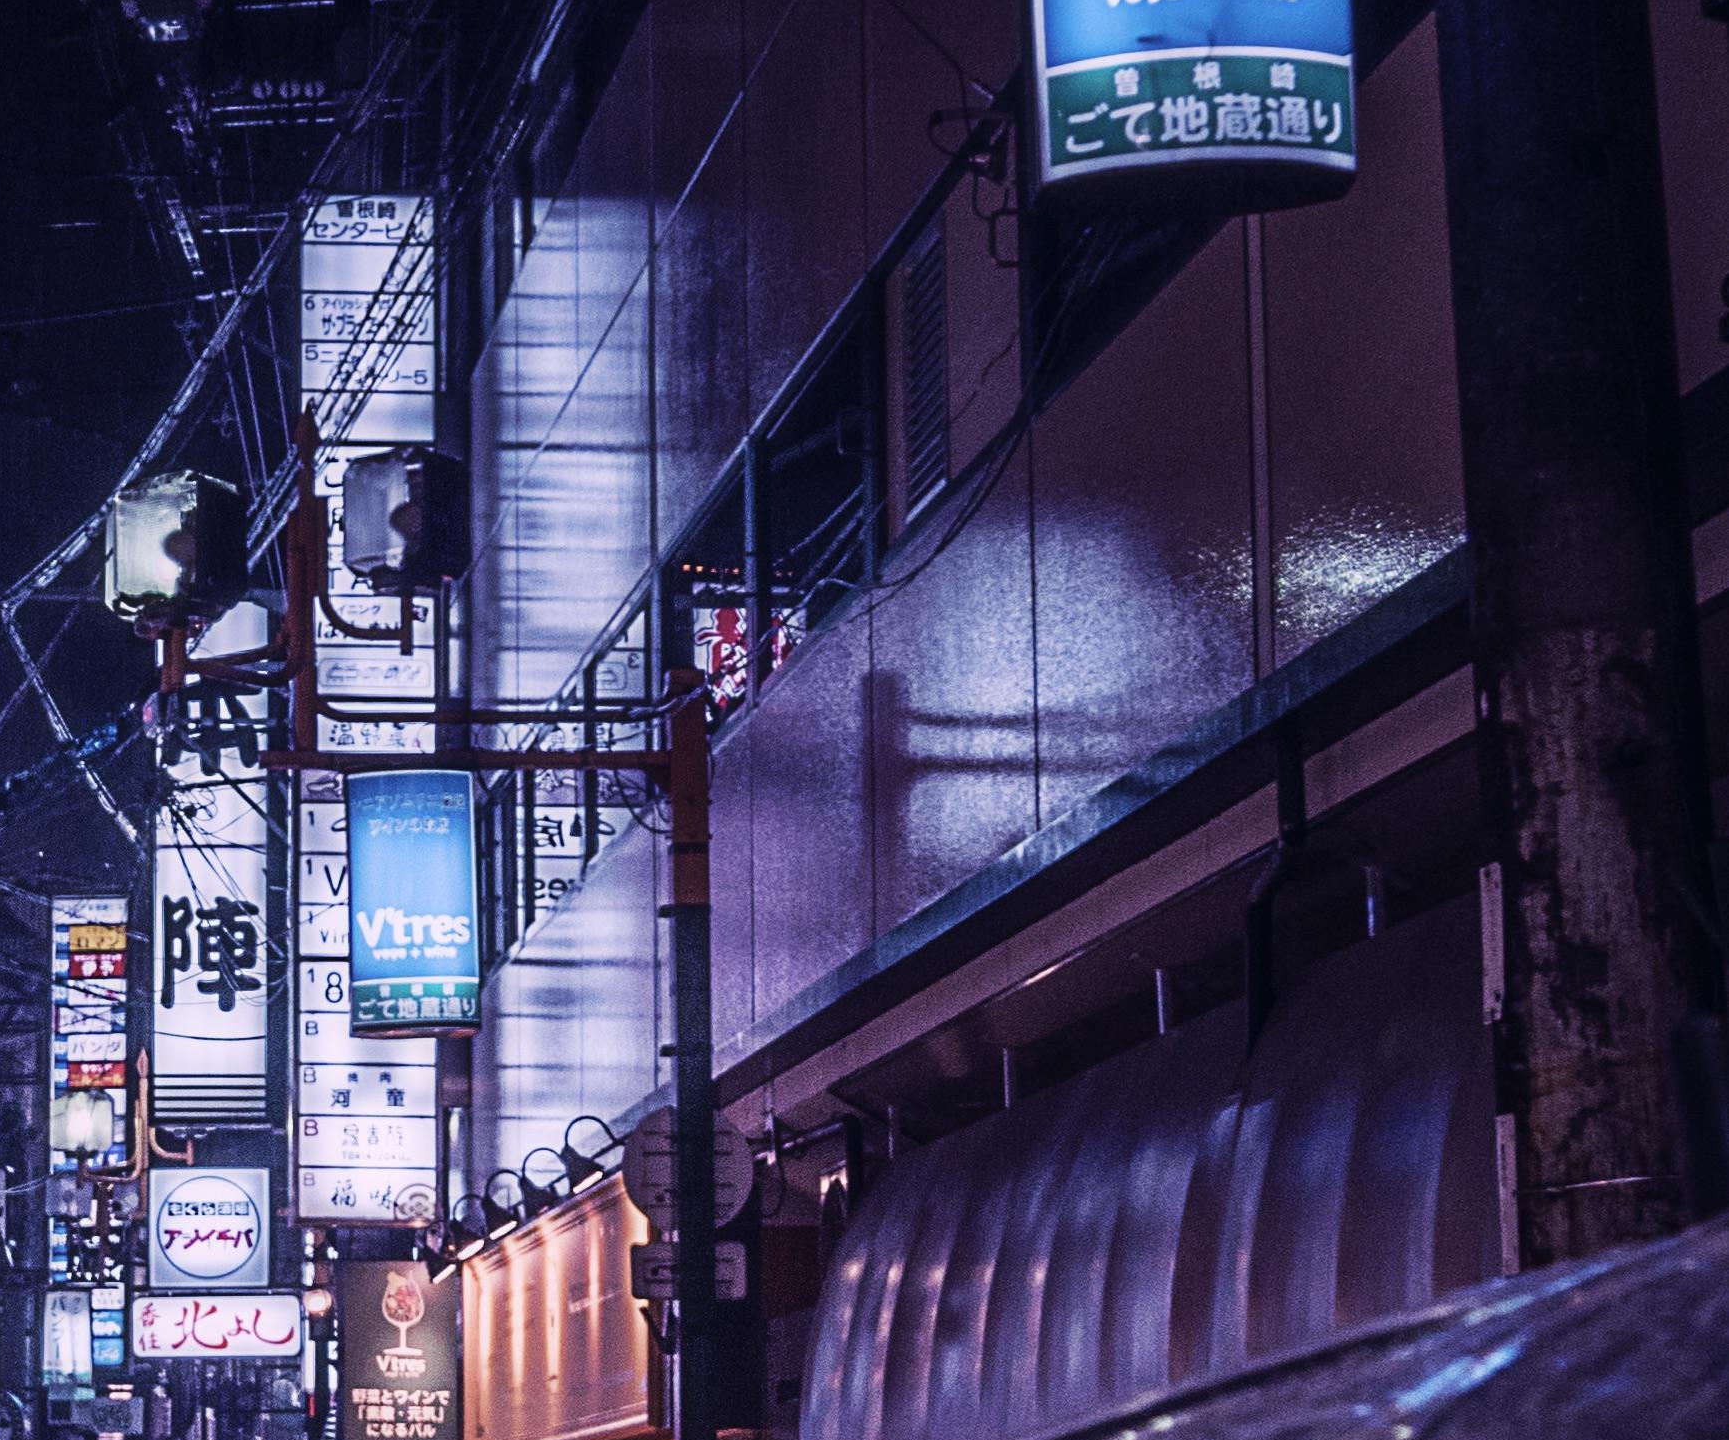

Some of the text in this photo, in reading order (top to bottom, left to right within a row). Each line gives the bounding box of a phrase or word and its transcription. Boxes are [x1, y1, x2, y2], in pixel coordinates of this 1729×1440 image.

[1064, 94, 1345, 153] ごて地蔵通り
[356, 907, 471, 948] V'tres
[331, 1087, 406, 1108] 河童
[171, 1300, 295, 1351] 北よし
[351, 1388, 450, 1405] 野菜とワインで
[365, 1423, 437, 1438] になるバル
